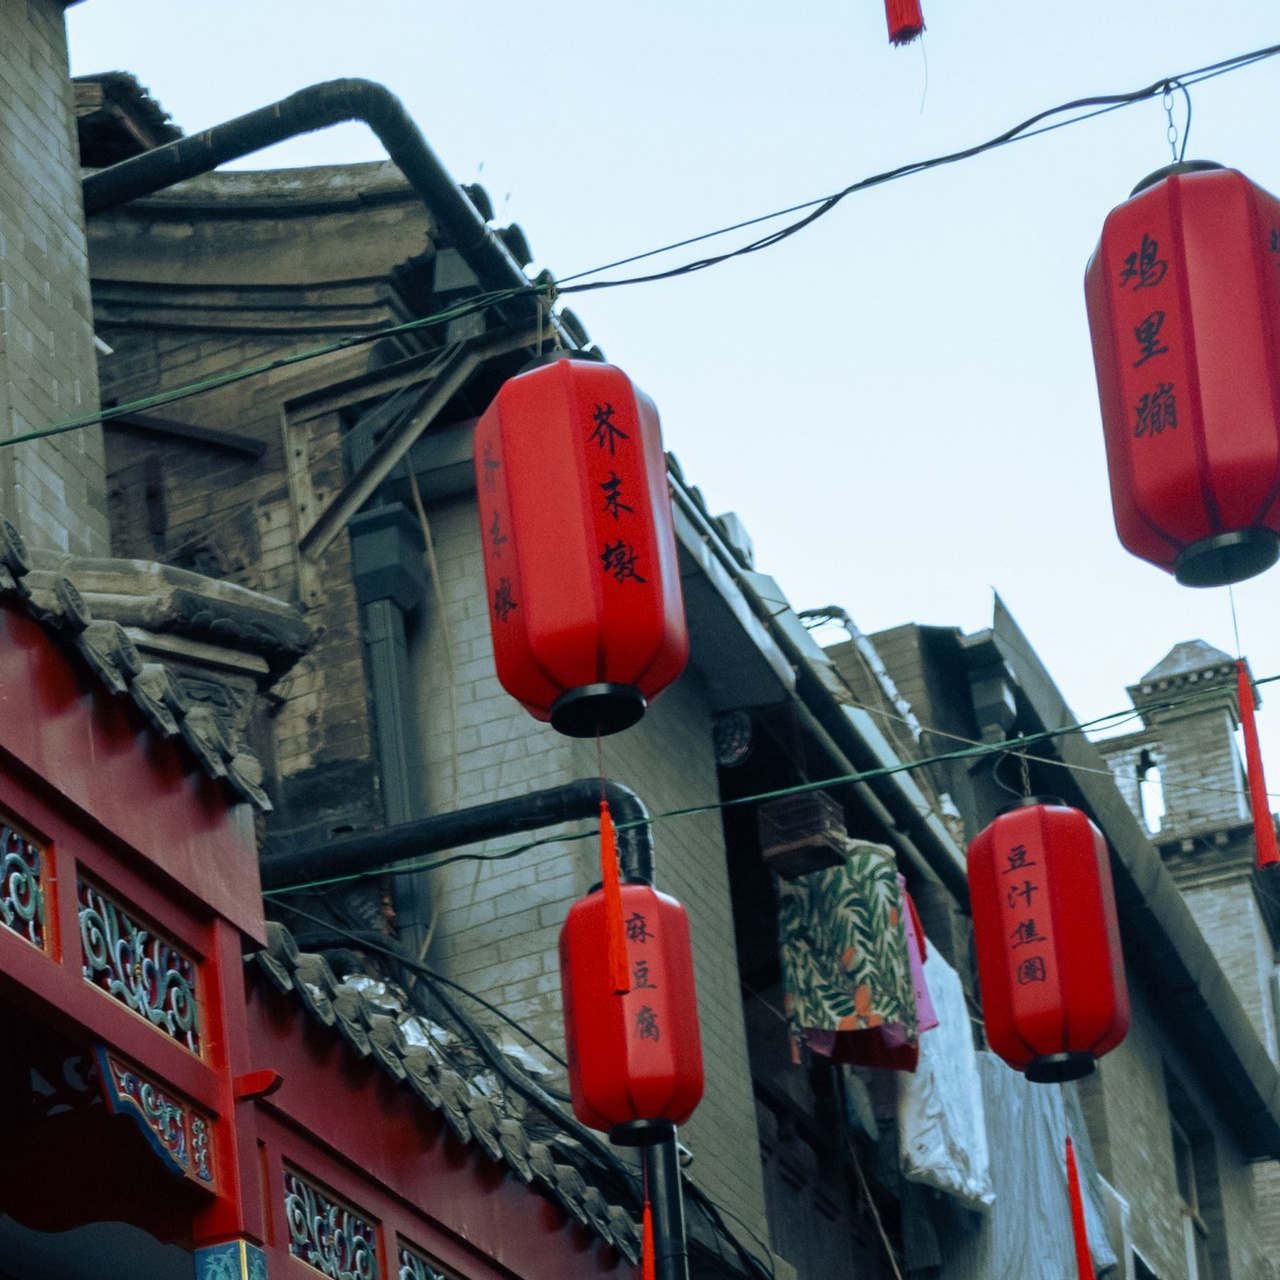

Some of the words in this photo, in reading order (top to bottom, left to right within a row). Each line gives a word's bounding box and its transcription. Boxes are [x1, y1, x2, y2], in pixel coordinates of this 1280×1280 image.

[1120, 233, 1178, 438] 鸡里蹦
[588, 403, 648, 584] 芥末墩
[624, 912, 660, 1043] 麻豆腐
